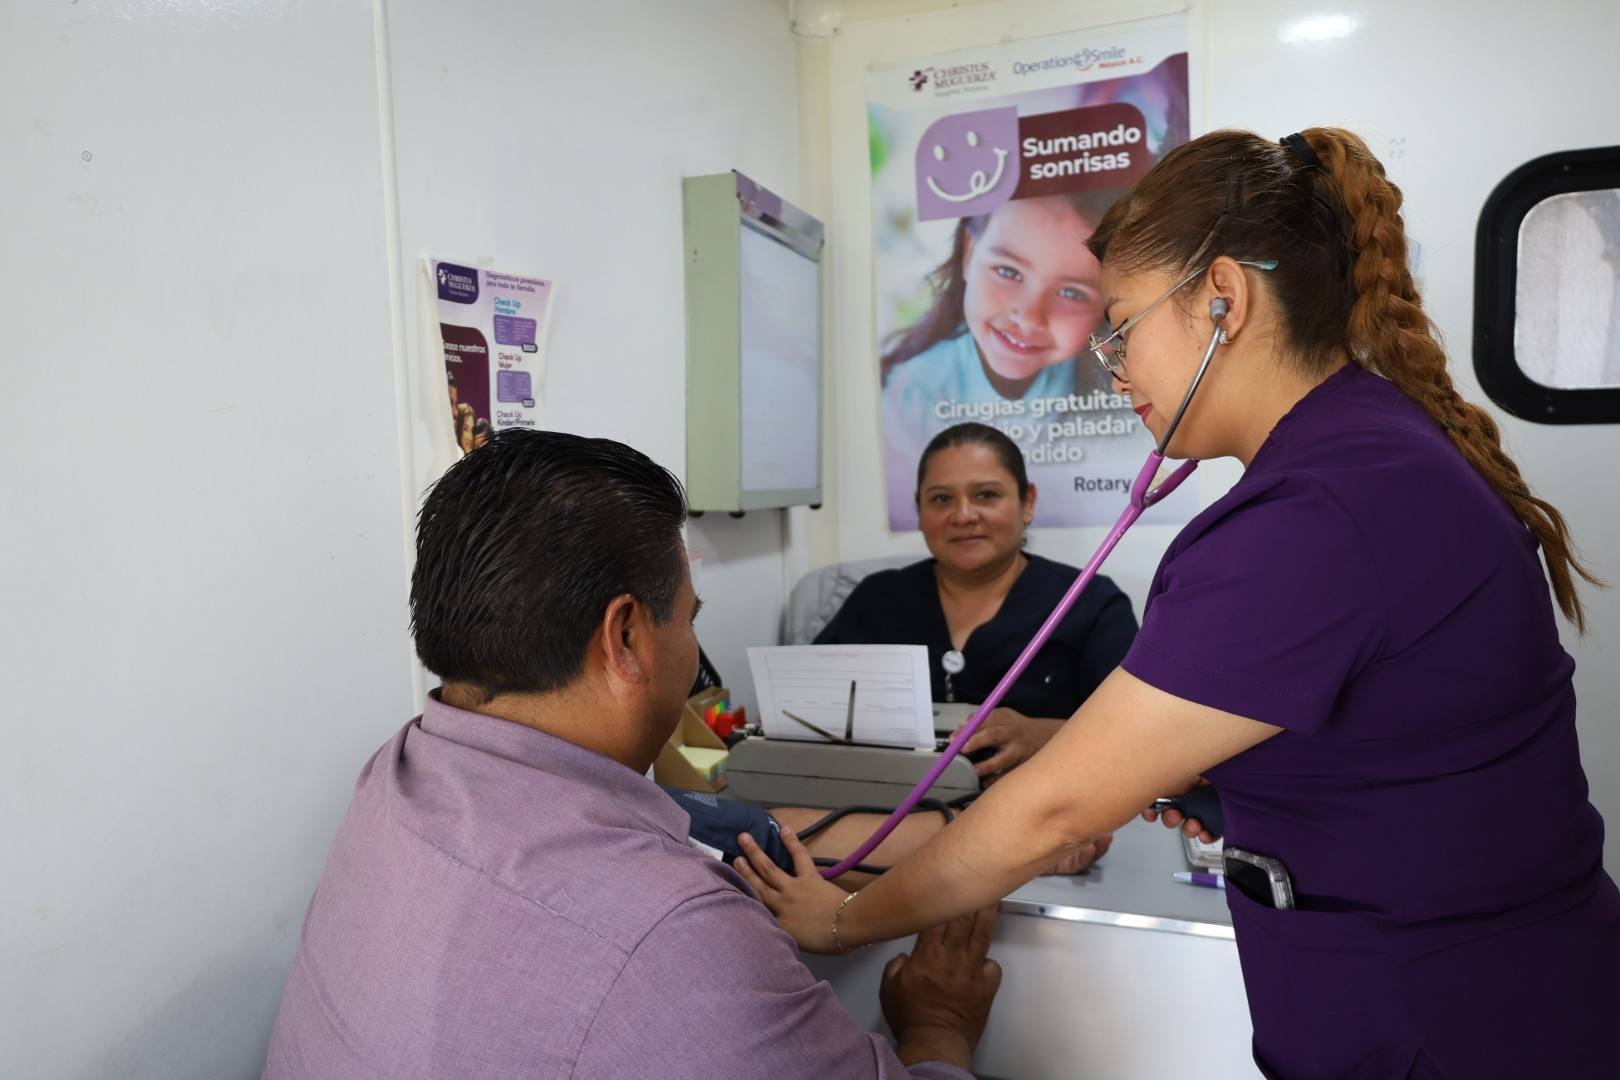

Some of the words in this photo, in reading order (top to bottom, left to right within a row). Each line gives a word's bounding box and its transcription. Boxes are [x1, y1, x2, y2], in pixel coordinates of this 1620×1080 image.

[934, 63, 989, 79] CHRISTUS
[934, 72, 996, 89] MUGUERZA
[1023, 123, 1141, 157] Sumando
[1030, 152, 1130, 179] sonrisas
[1030, 389, 1132, 418] gratuitas
[1028, 423, 1041, 443] y
[1048, 415, 1136, 442] paladar
[1074, 475, 1132, 493] Rotary
